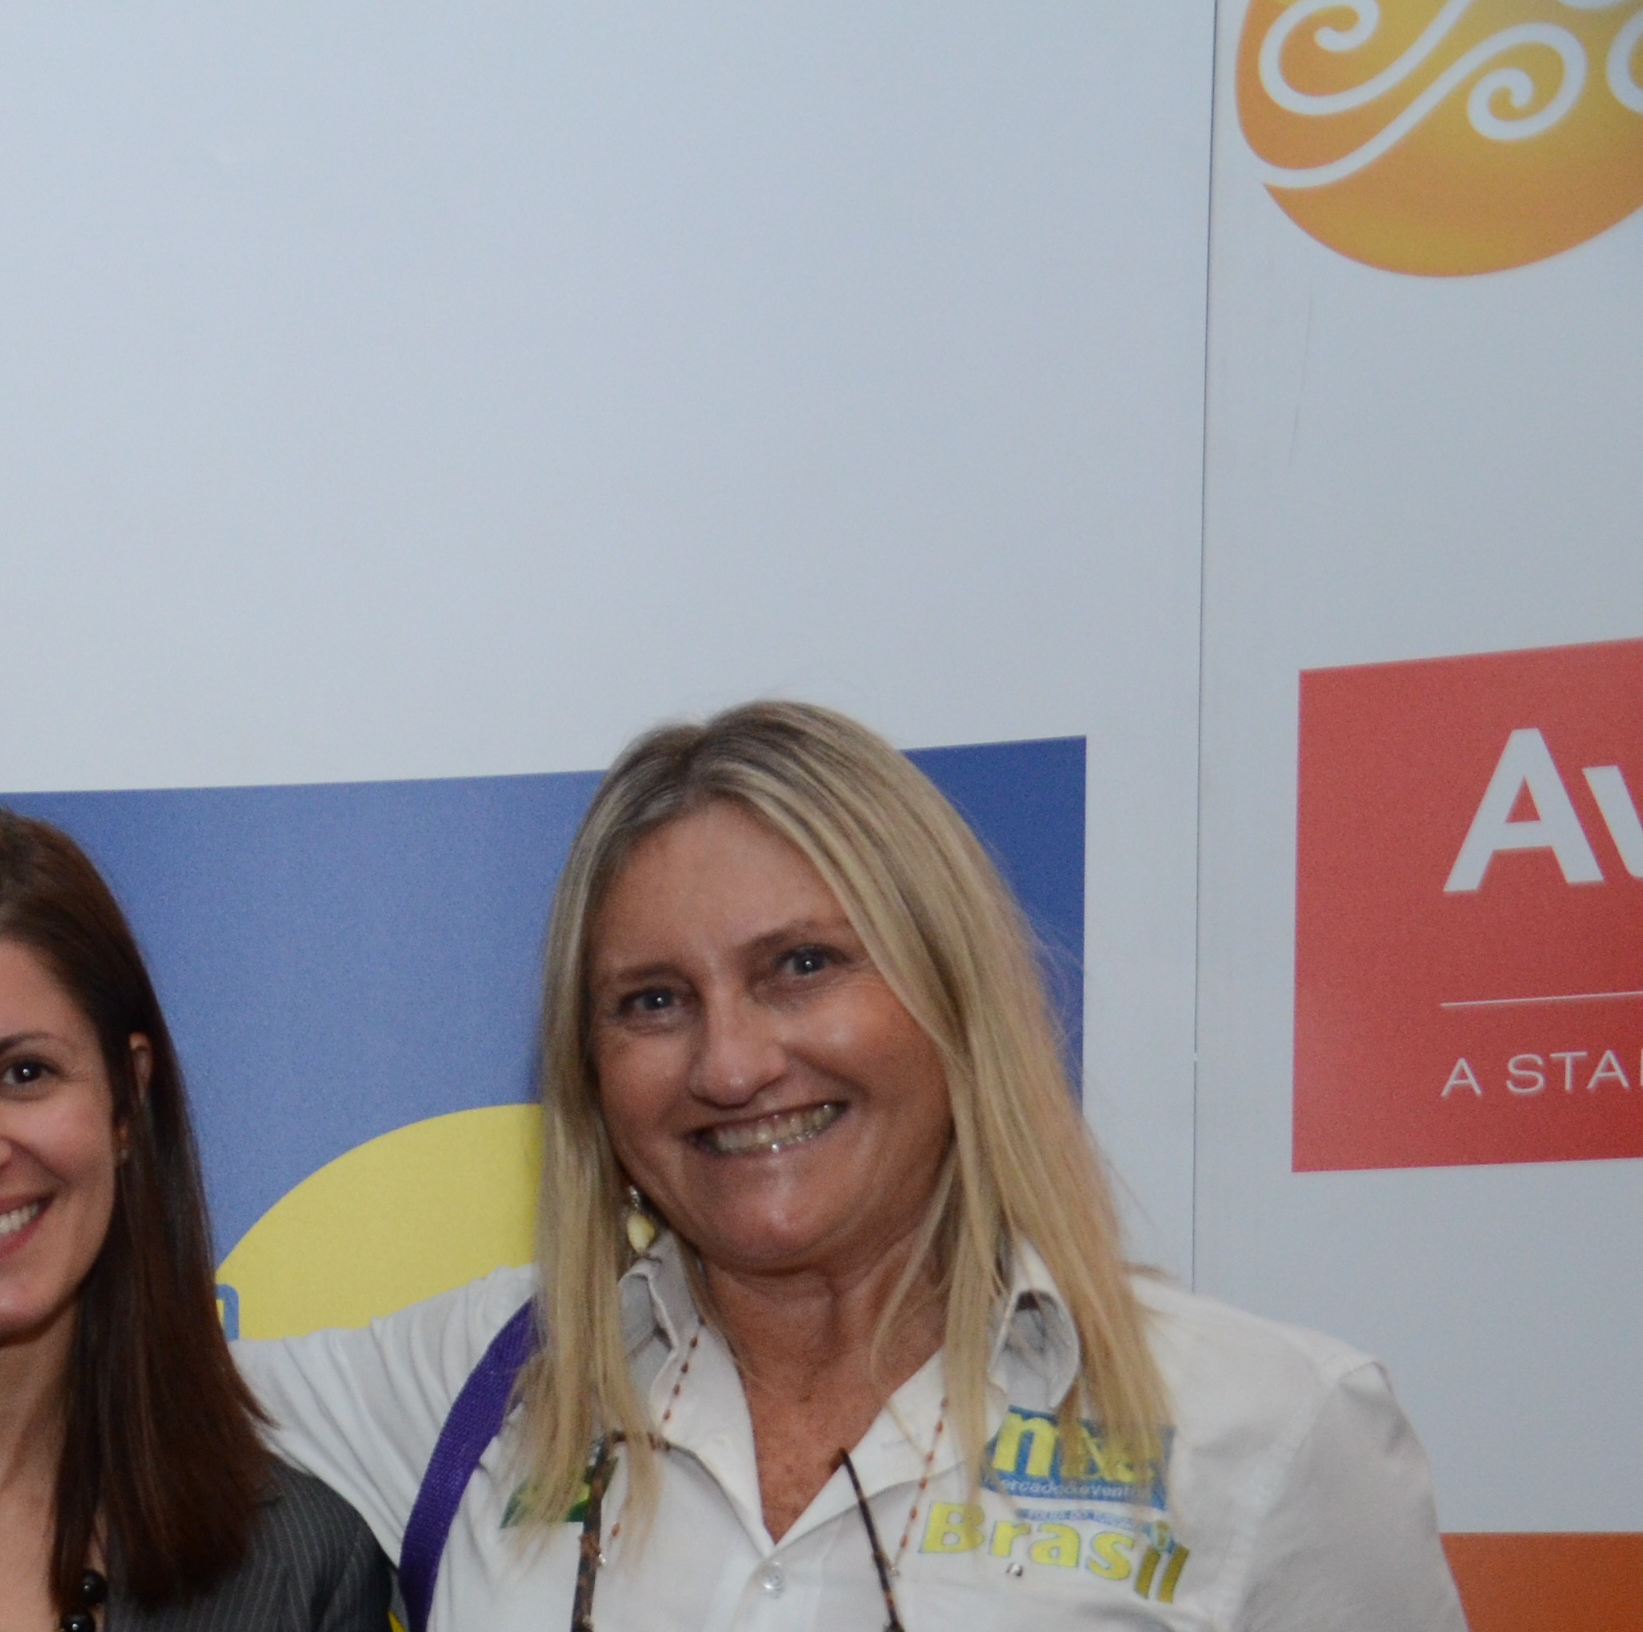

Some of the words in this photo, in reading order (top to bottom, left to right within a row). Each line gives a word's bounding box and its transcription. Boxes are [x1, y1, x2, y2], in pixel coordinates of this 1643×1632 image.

[1441, 1057, 1482, 1098] A
[1506, 1049, 1643, 1095] STA
[918, 1500, 1190, 1604] Brasil
